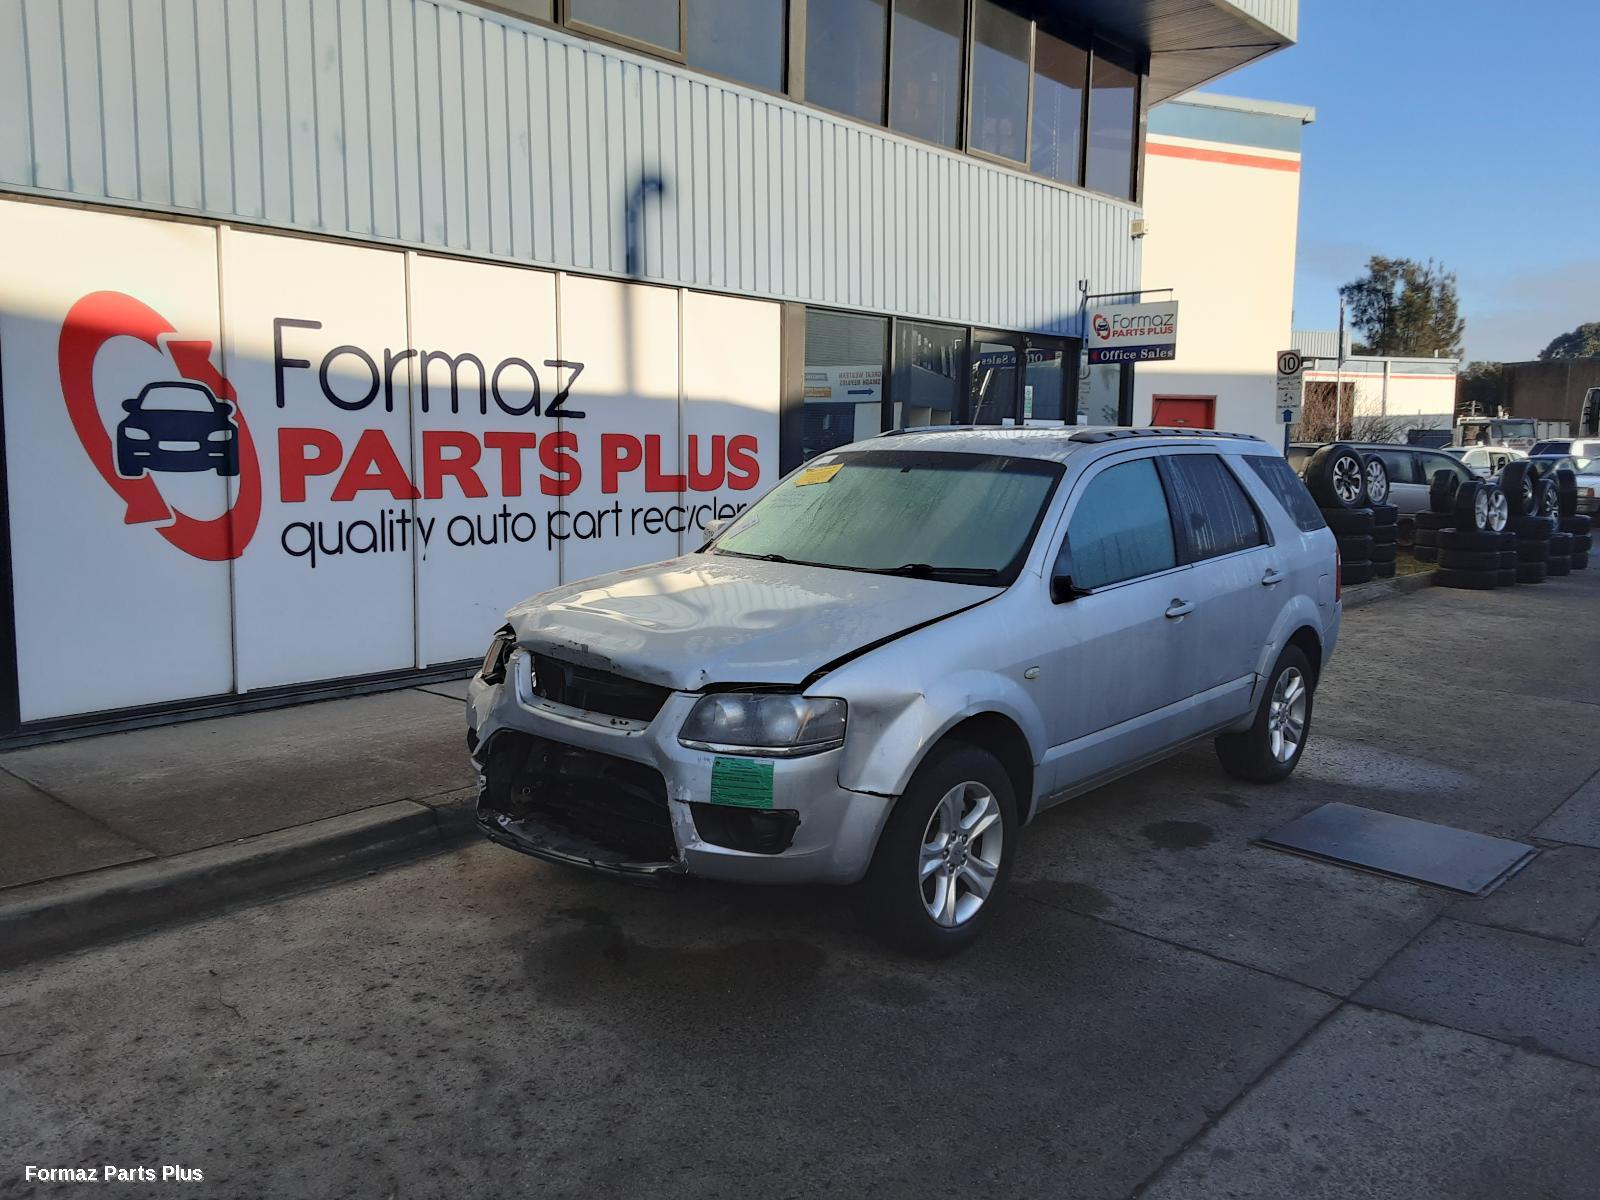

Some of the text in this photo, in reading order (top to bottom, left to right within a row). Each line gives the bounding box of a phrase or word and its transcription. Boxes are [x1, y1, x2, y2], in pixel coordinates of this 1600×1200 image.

[1112, 313, 1174, 329] Formaz
[1112, 326, 1174, 338] PARTS PLUS
[1100, 348, 1174, 361] Office Sales
[273, 317, 586, 418] Formaz
[1282, 356, 1296, 371] 10
[278, 427, 760, 503] PARTS PLUS
[281, 496, 747, 568] quality auto part recycler
